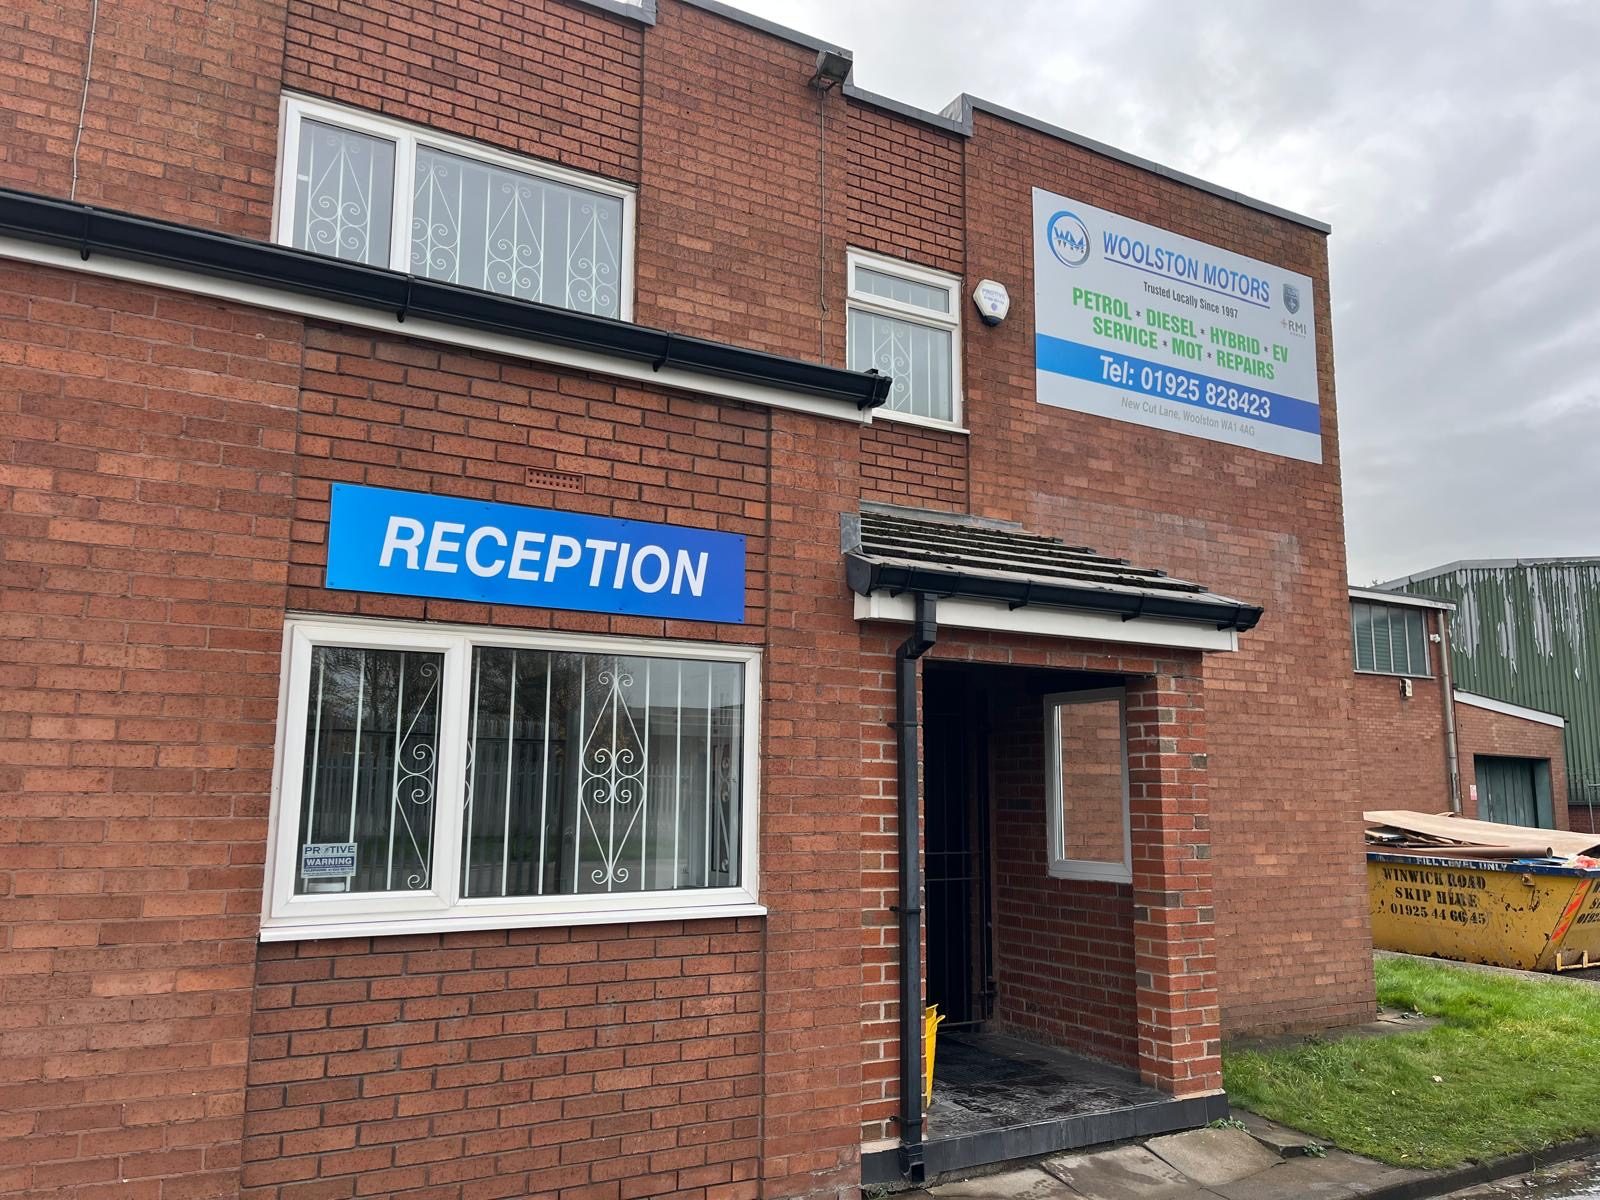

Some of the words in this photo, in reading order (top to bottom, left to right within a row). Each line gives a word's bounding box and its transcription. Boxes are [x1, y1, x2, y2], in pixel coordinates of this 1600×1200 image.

[1103, 231, 1199, 280] WOOLSTON
[1203, 263, 1270, 303] MOTORS
[1143, 281, 1171, 299] Trusted
[1172, 290, 1198, 309] Locally
[1199, 298, 1220, 314] Since
[1221, 305, 1239, 319] 1997
[1072, 287, 1132, 321] PETROL
[1146, 308, 1197, 338] DIESEL
[1210, 326, 1260, 356] HYBRID
[1272, 343, 1288, 364] EV
[1092, 316, 1158, 350] SERVICE
[1172, 337, 1203, 361] MOT
[1216, 349, 1275, 380] REPAIRS
[1100, 355, 1134, 386] Tel:
[1140, 367, 1200, 401] 01925
[1205, 382, 1271, 418] 828423
[1121, 397, 1140, 409] New
[1142, 401, 1157, 415] Cut
[1159, 405, 1180, 420] Lane,
[1183, 410, 1219, 427] Woolston
[1221, 420, 1237, 432] WA1
[378, 515, 709, 597] RECEPTION
[306, 857, 352, 866] WARNING
[1382, 867, 1444, 886] WINWICK
[1447, 873, 1486, 890] ROAD
[1390, 902, 1428, 918] 01925
[1431, 908, 1446, 920] 44
[1395, 887, 1431, 903] SKIP
